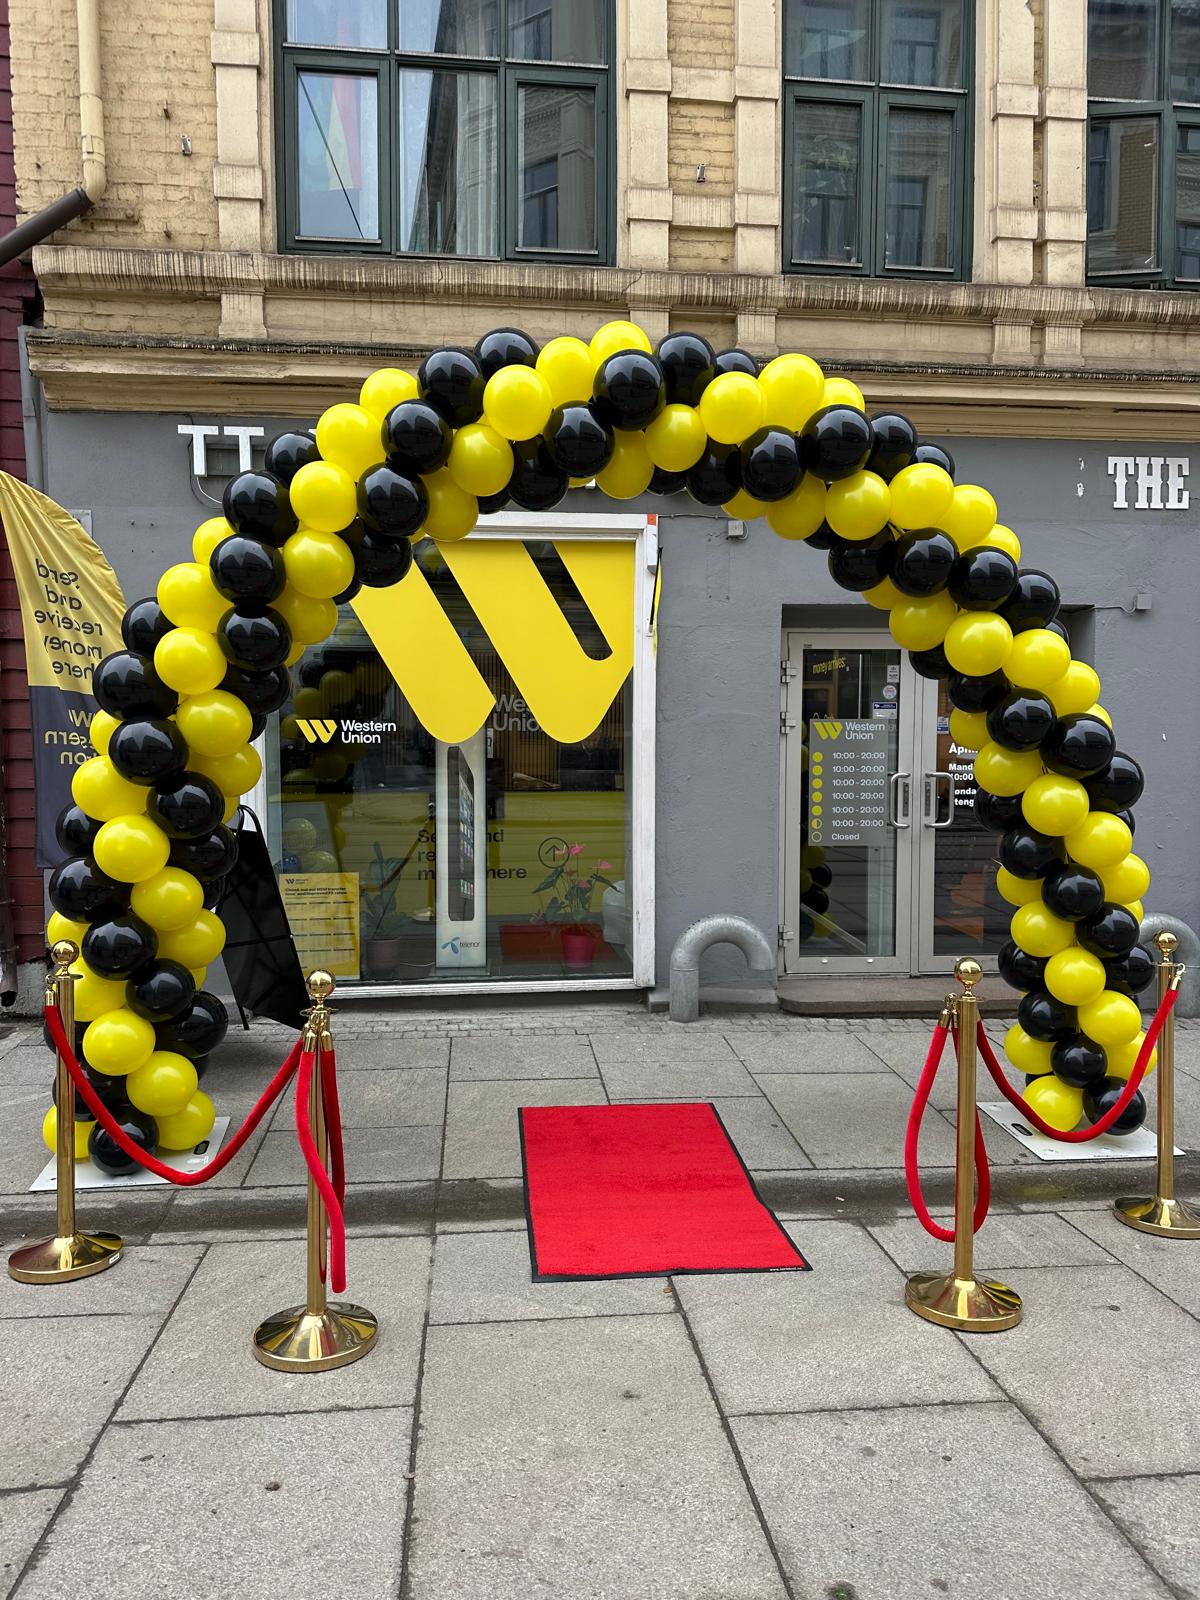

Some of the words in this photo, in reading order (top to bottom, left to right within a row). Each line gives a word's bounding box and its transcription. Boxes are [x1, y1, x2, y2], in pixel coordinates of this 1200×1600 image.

[1107, 456, 1189, 509] THE
[341, 719, 397, 732] Western
[845, 721, 886, 731] Western
[341, 731, 381, 744] Union
[845, 731, 874, 740] Union
[832, 765, 855, 773] 10:00
[860, 765, 885, 773] 20:00
[948, 763, 974, 771] Mand
[832, 792, 855, 800] 10:00
[860, 792, 884, 800] 20:00
[954, 798, 975, 807] teng
[832, 806, 855, 814] 10:00
[860, 806, 884, 814] 20:00
[831, 819, 854, 827] 10:00
[860, 819, 884, 827] 20:00
[831, 833, 860, 841] Closed
